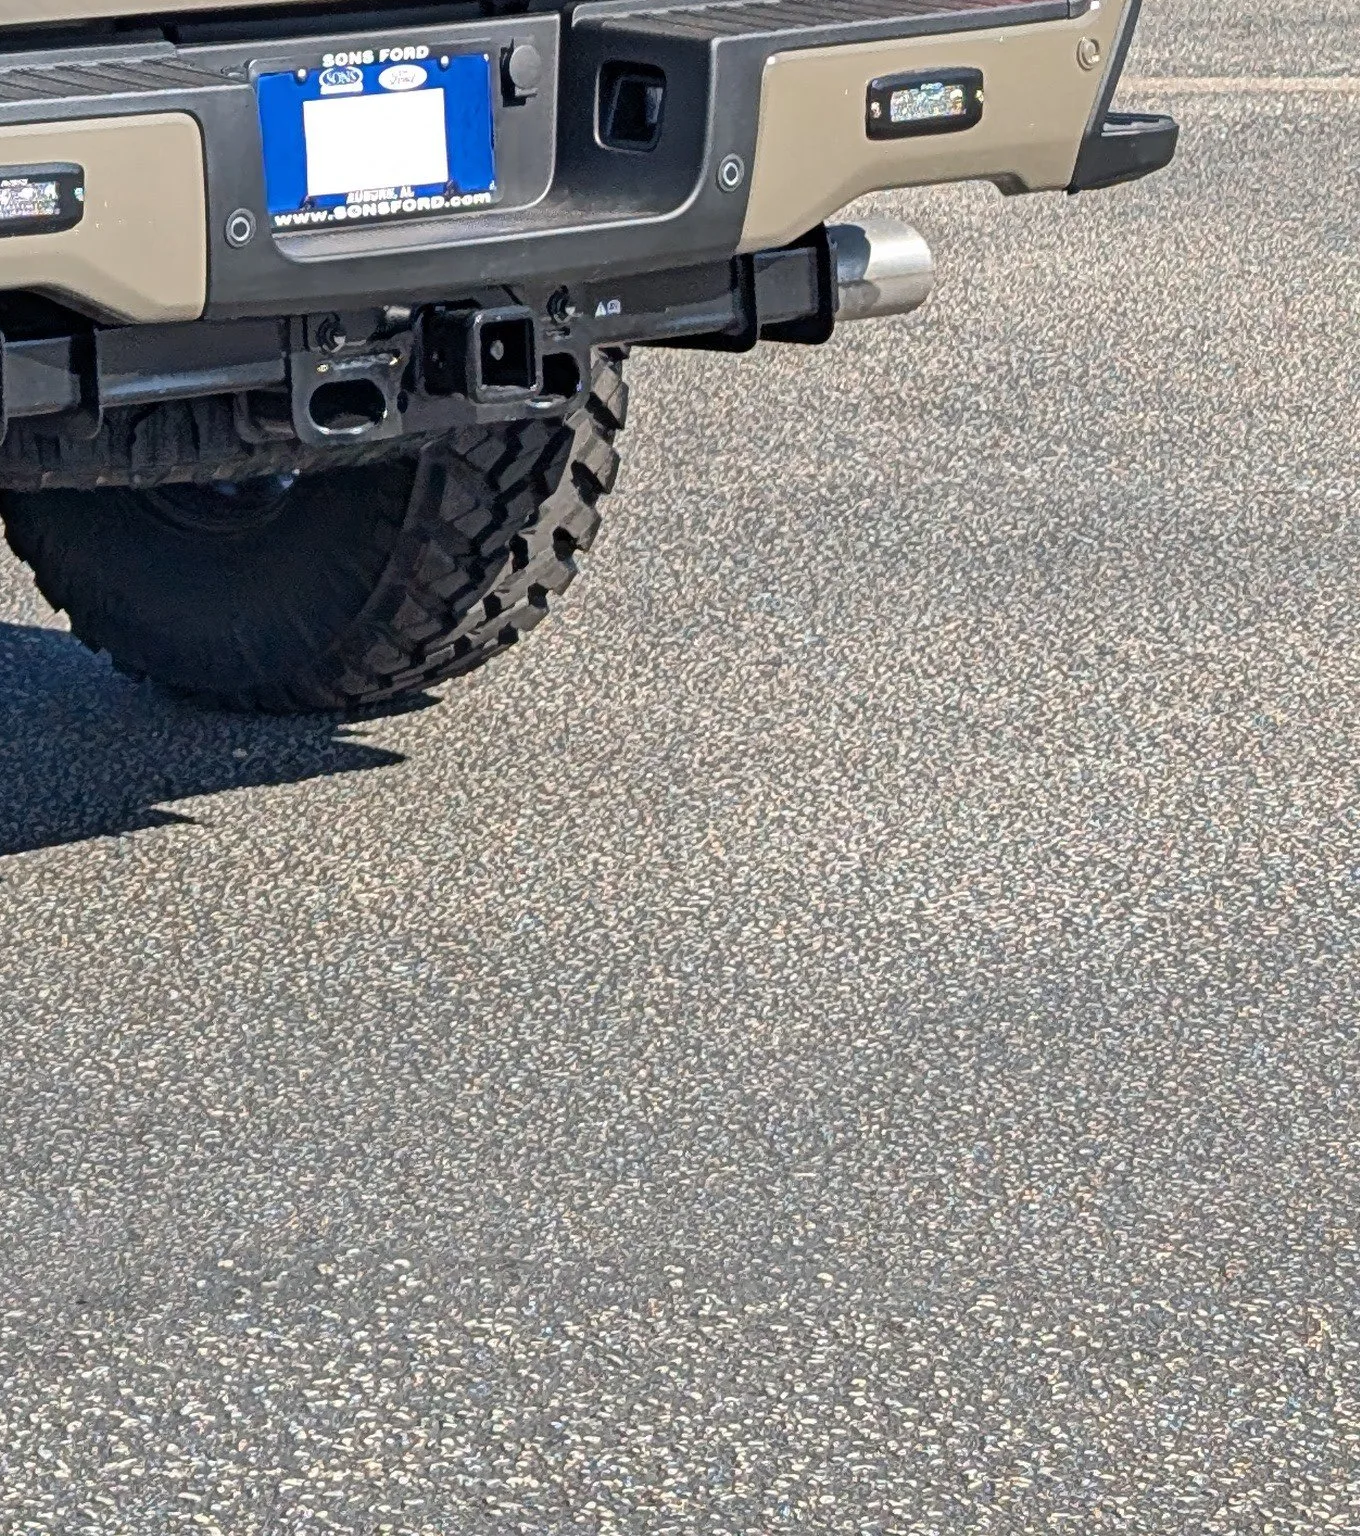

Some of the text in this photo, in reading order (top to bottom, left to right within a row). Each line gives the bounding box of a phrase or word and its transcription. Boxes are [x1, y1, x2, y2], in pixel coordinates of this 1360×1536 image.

[322, 45, 429, 67] SONS FORD
[274, 191, 491, 227] www.SONSFORD.com
